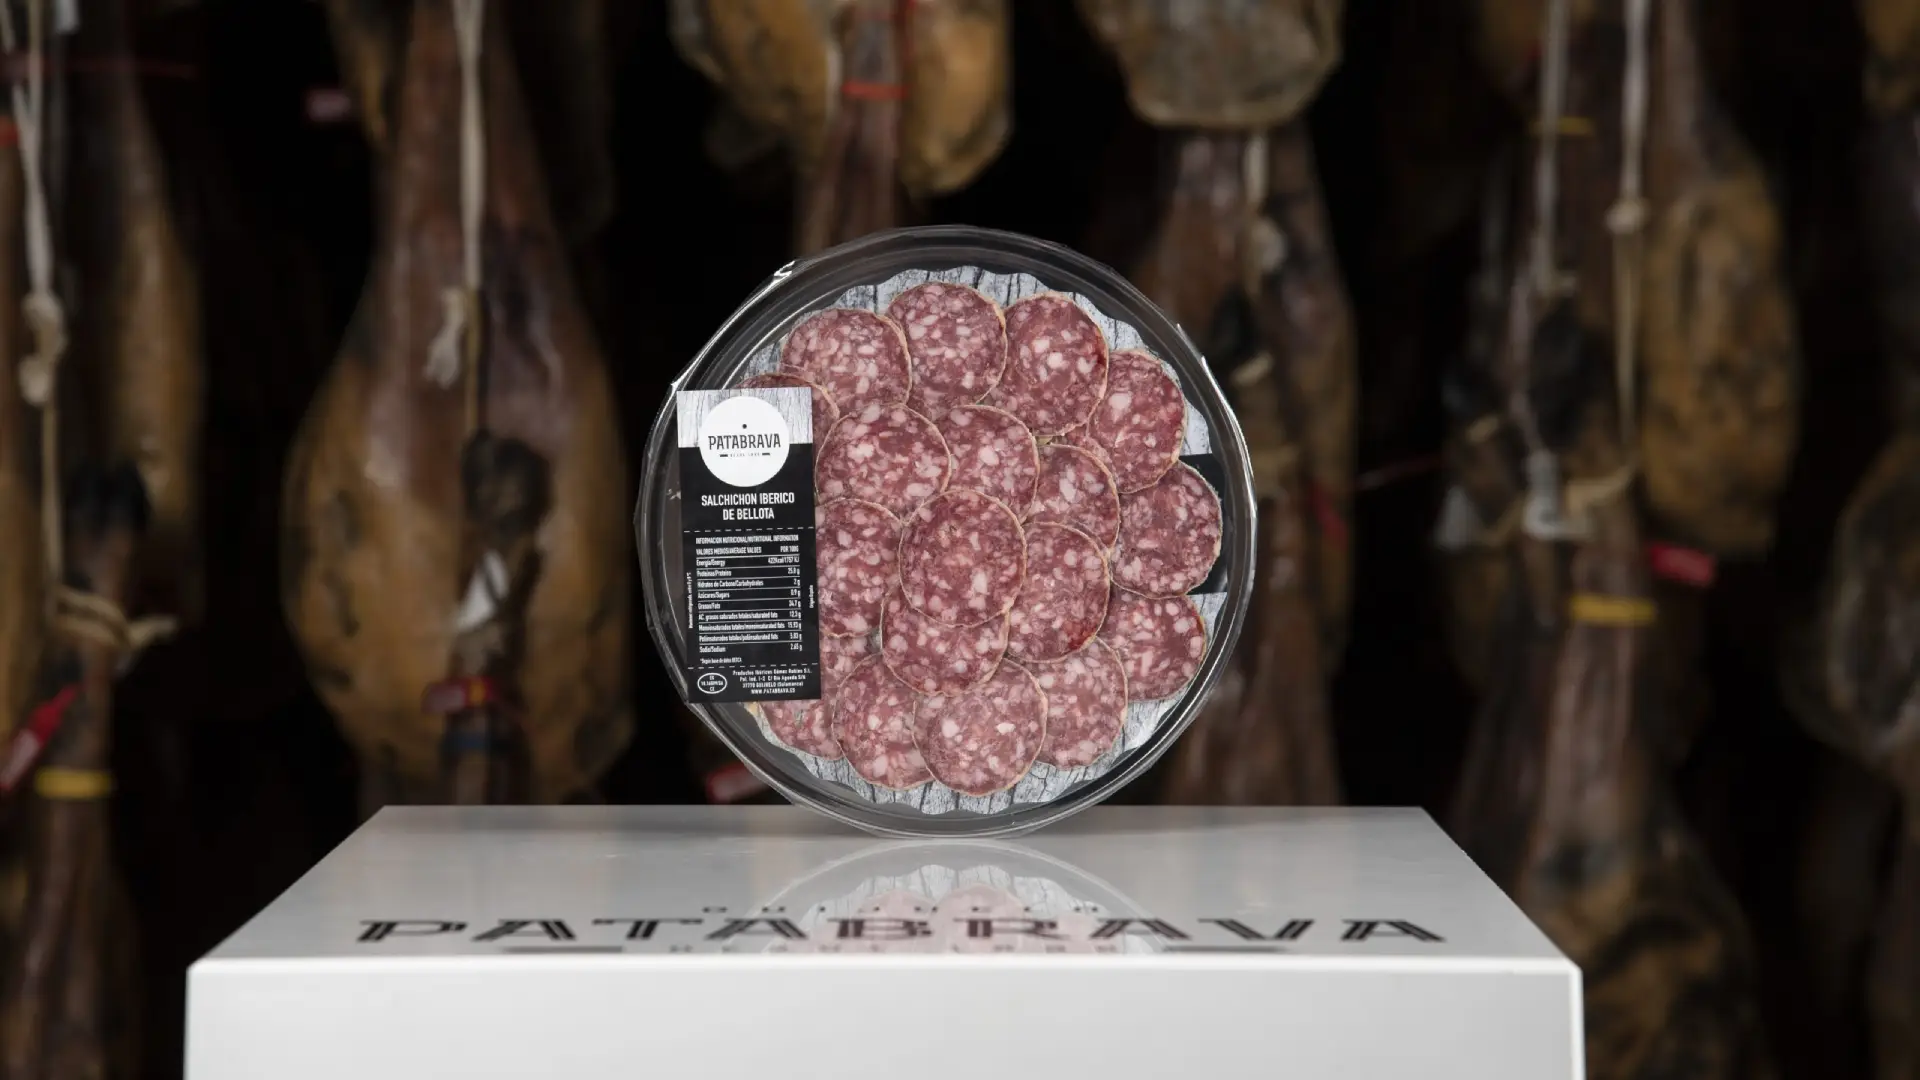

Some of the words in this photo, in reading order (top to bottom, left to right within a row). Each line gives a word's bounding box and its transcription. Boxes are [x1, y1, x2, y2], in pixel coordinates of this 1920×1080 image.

[708, 433, 781, 450] PATABRAVA
[701, 493, 757, 506] SALCHICHON
[759, 492, 795, 504] IBERICO
[722, 509, 734, 520] DE
[737, 508, 774, 520] BELLOTA
[356, 917, 1447, 943] PATABRAVA
